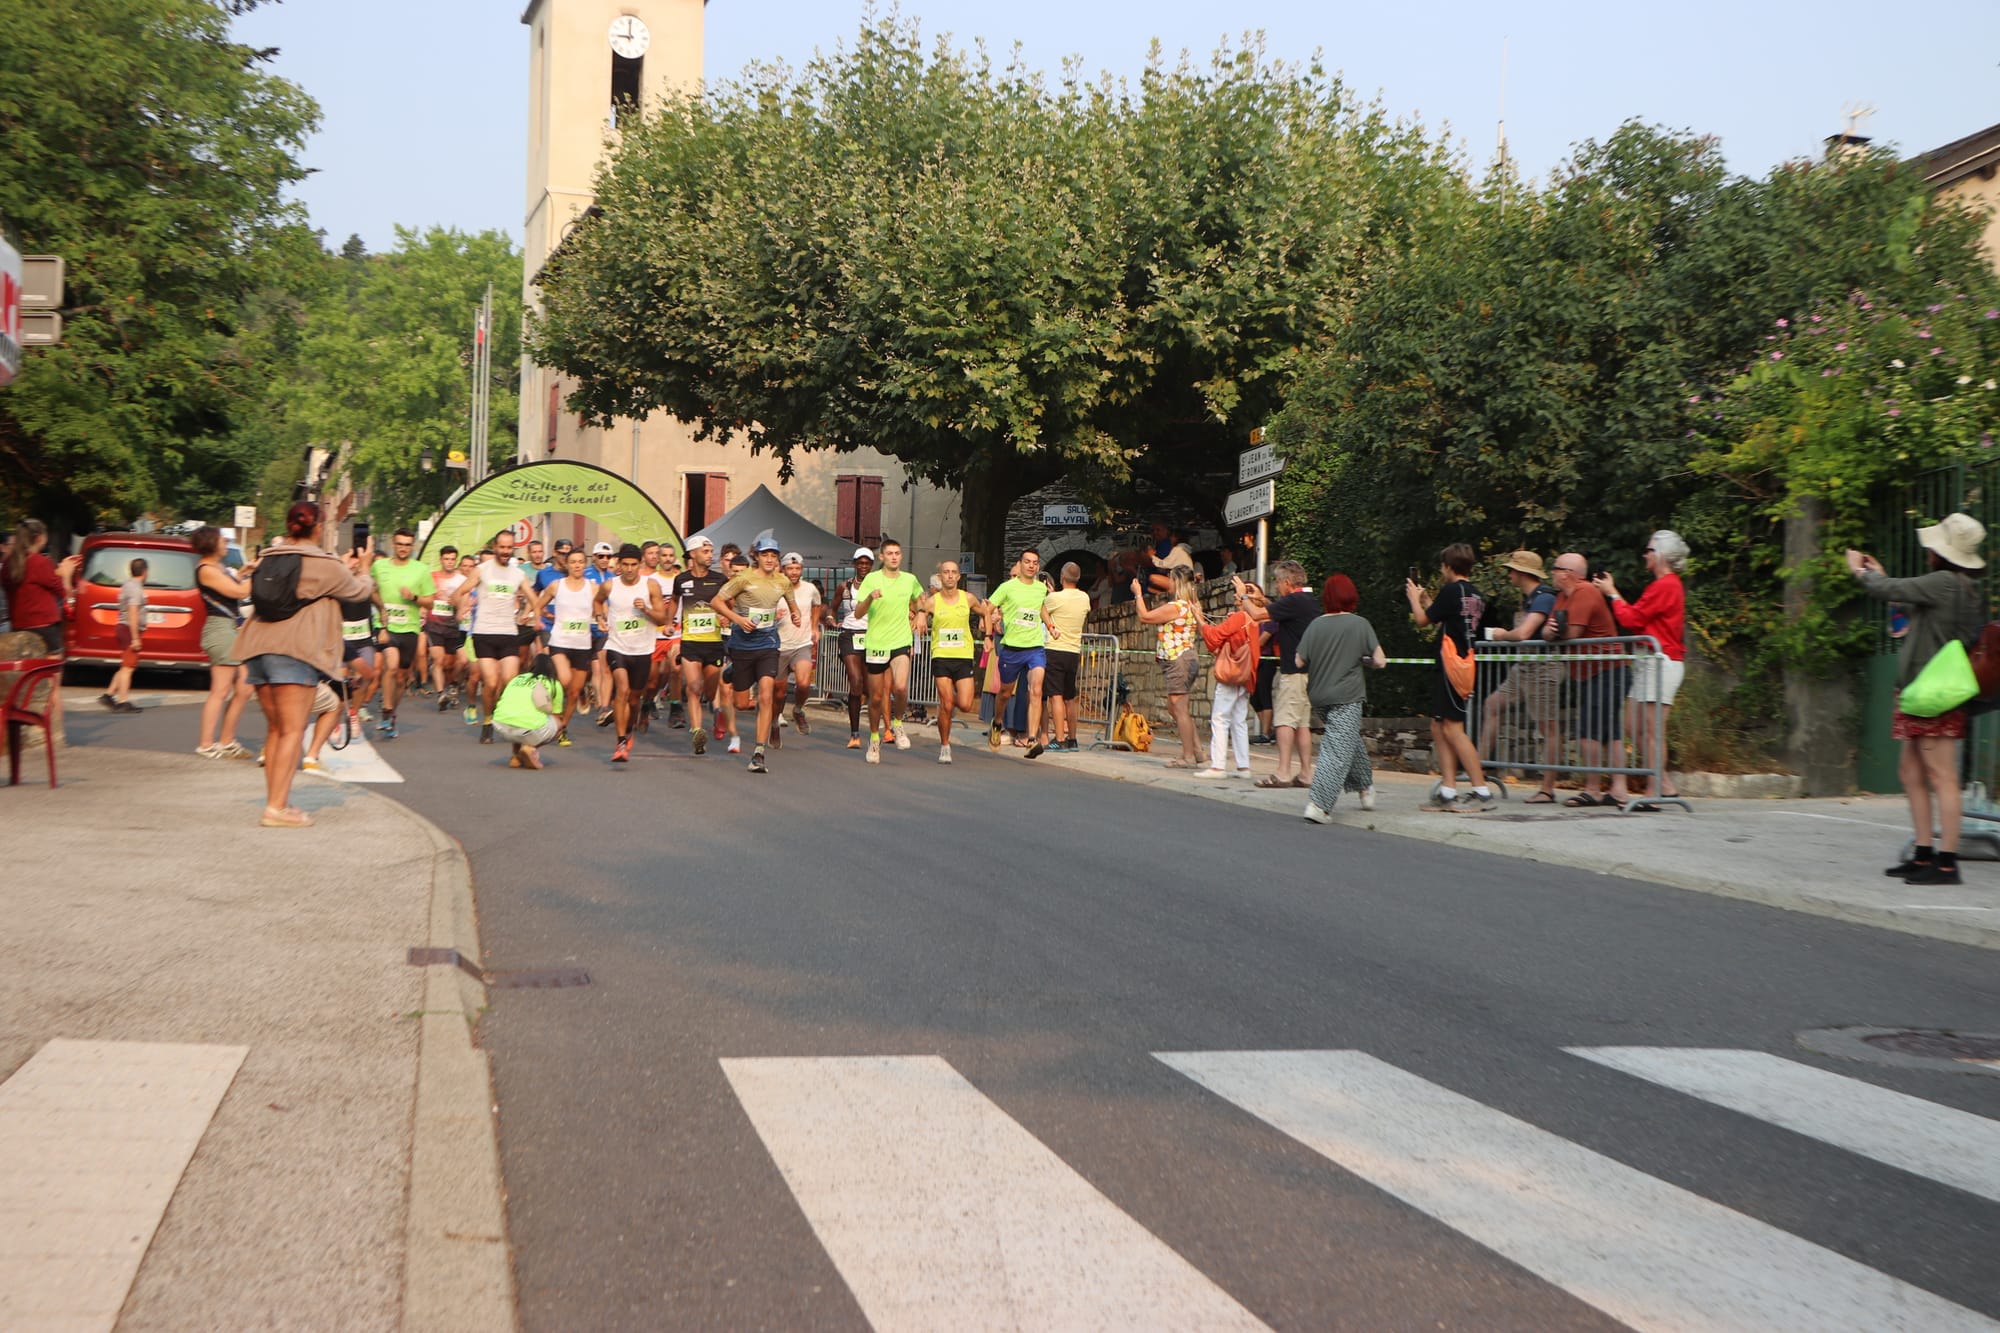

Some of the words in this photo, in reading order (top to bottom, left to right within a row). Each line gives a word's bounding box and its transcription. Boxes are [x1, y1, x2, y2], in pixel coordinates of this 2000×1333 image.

[511, 479, 579, 495] Challenge
[587, 482, 610, 491] des
[502, 492, 550, 503] vallées
[559, 494, 617, 504] cévenoles
[1044, 516, 1089, 525] POLYVAL
[1023, 612, 1034, 621] 25
[569, 622, 582, 630] 87
[624, 620, 639, 630] 20
[692, 618, 712, 627] 124
[945, 633, 958, 641] 14
